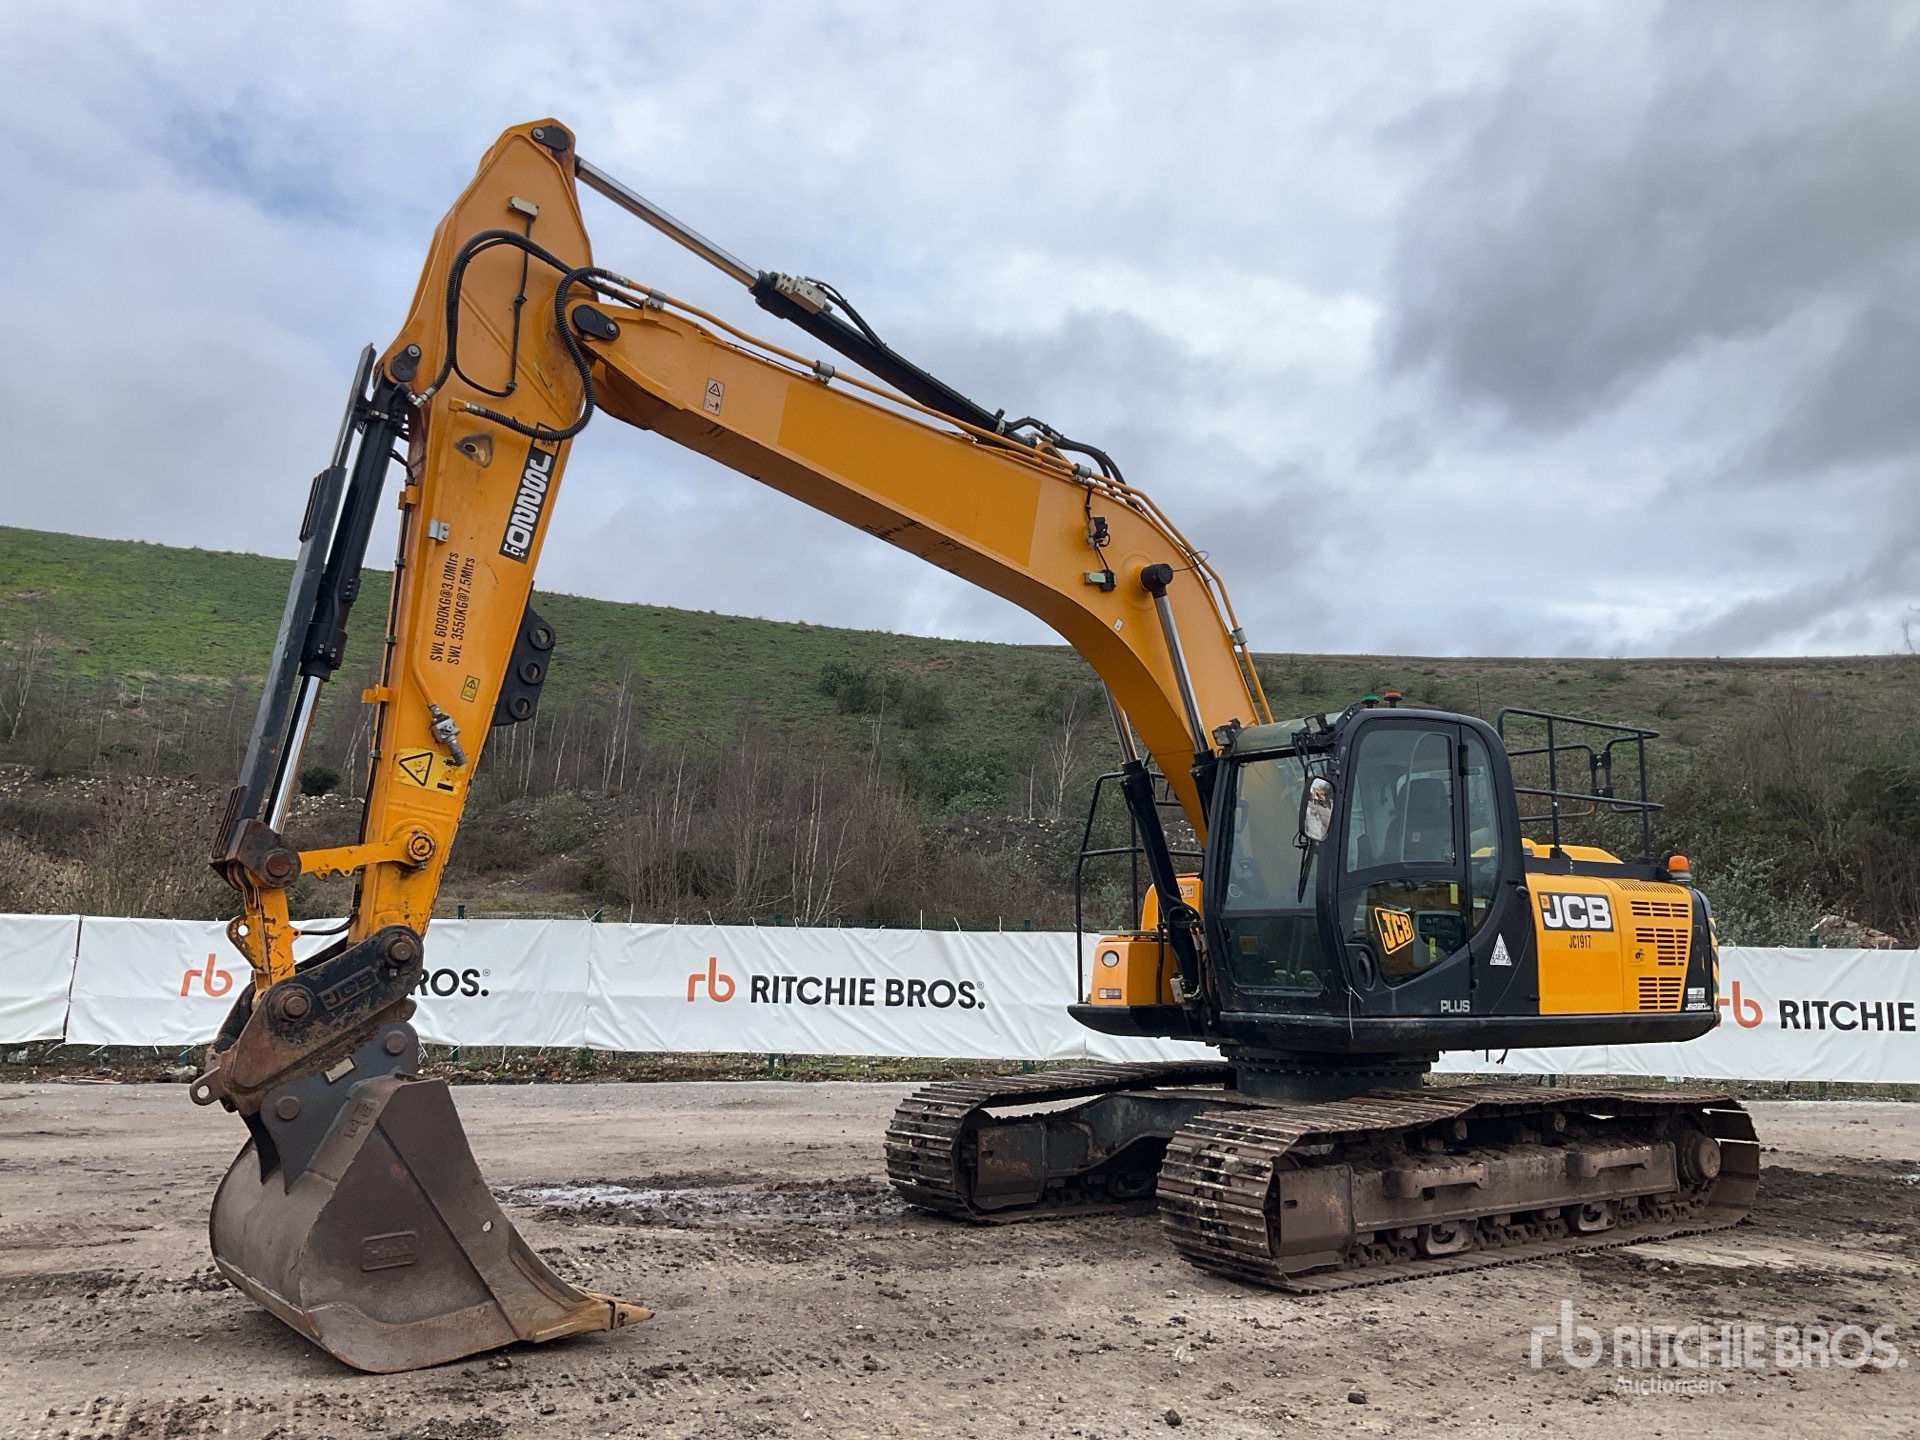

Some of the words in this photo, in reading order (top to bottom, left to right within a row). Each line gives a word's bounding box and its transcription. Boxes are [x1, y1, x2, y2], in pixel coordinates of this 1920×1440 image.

[434, 552, 459, 637] 6090KG@3.0Mtrs
[451, 557, 476, 641] 3550KG@7.5Mtrs
[430, 641, 446, 662] SWL
[447, 645, 462, 665] SWL
[1542, 895, 1611, 929] JCB
[1382, 911, 1413, 950] JCB
[1568, 934, 1592, 949] JC1917
[180, 953, 233, 998] rb
[409, 968, 490, 998] ROS.
[687, 957, 736, 1003] rb
[750, 974, 875, 1007] RITCHIE
[885, 978, 986, 1010] BROS.
[1440, 1000, 1470, 1013] PLUS
[1779, 999, 1916, 1032] RITCHIE
